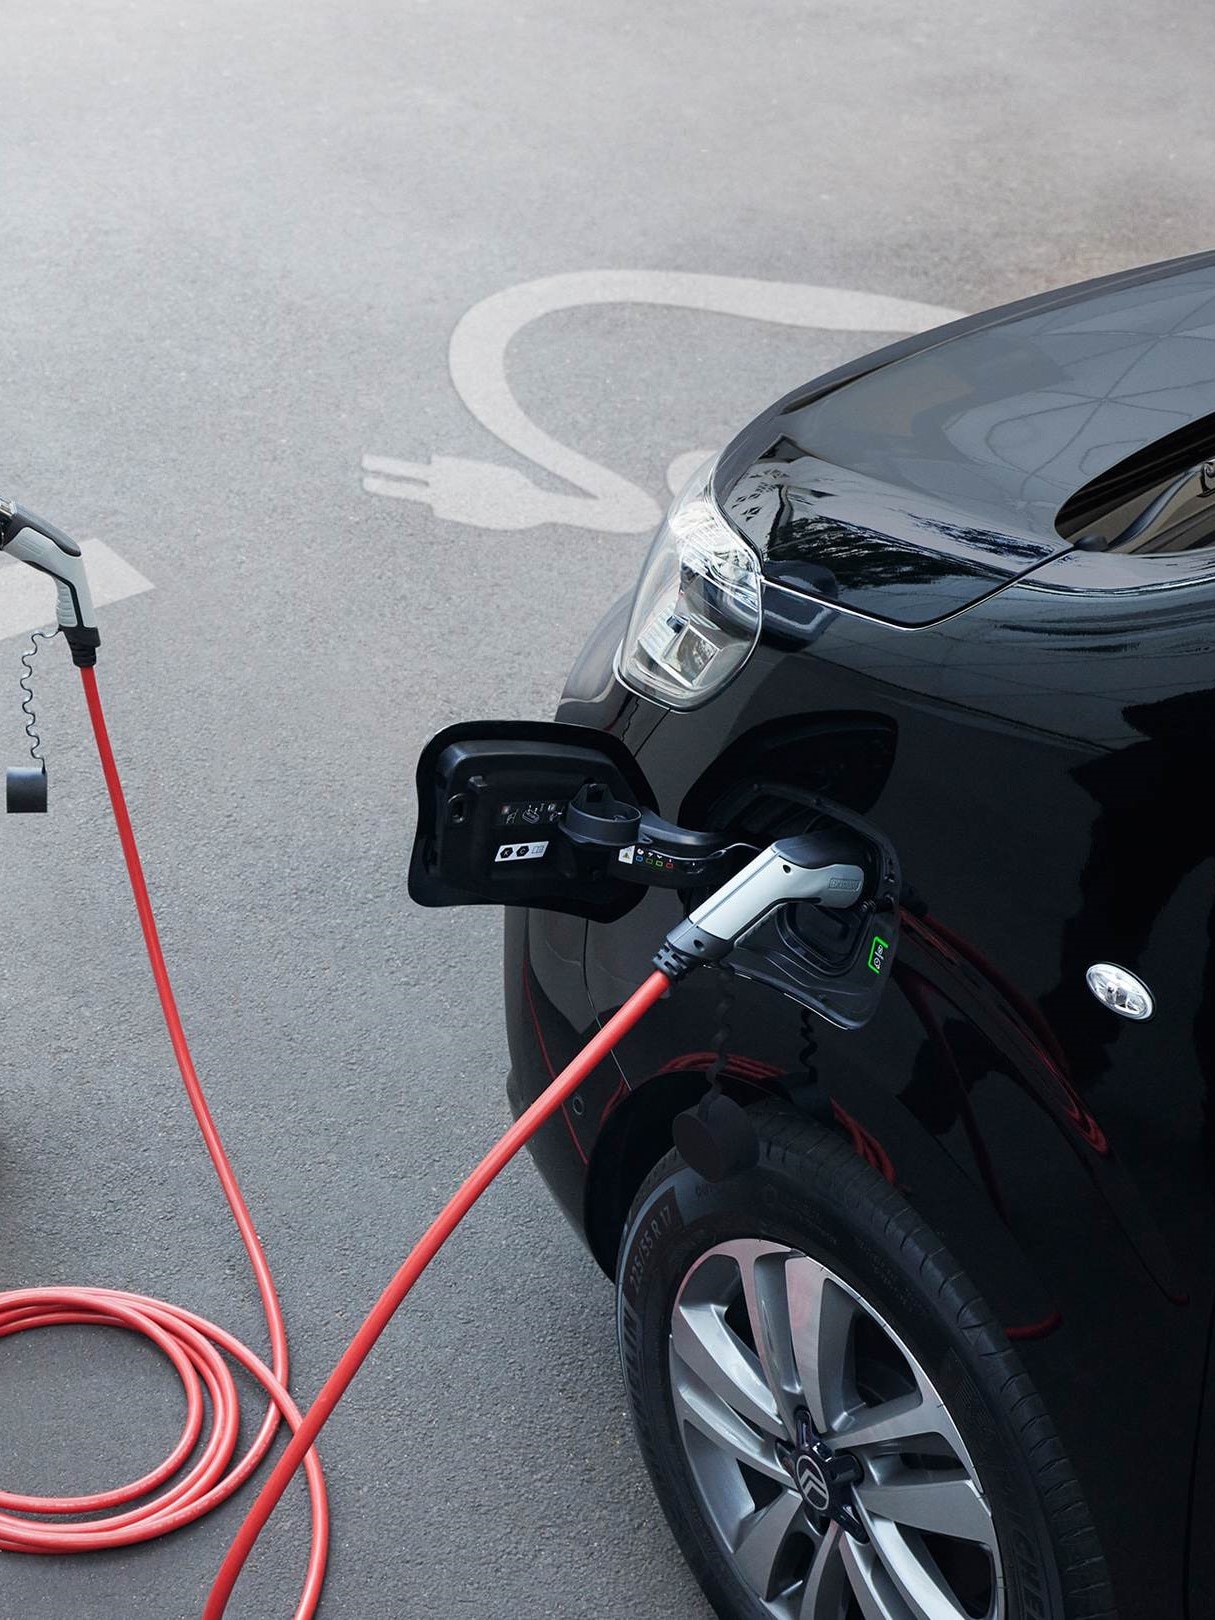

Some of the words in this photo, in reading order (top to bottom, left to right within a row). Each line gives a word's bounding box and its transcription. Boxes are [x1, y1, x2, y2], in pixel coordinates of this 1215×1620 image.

[629, 1230, 652, 1295] 225/55
[651, 1219, 662, 1240] R
[660, 1205, 673, 1227] 17
